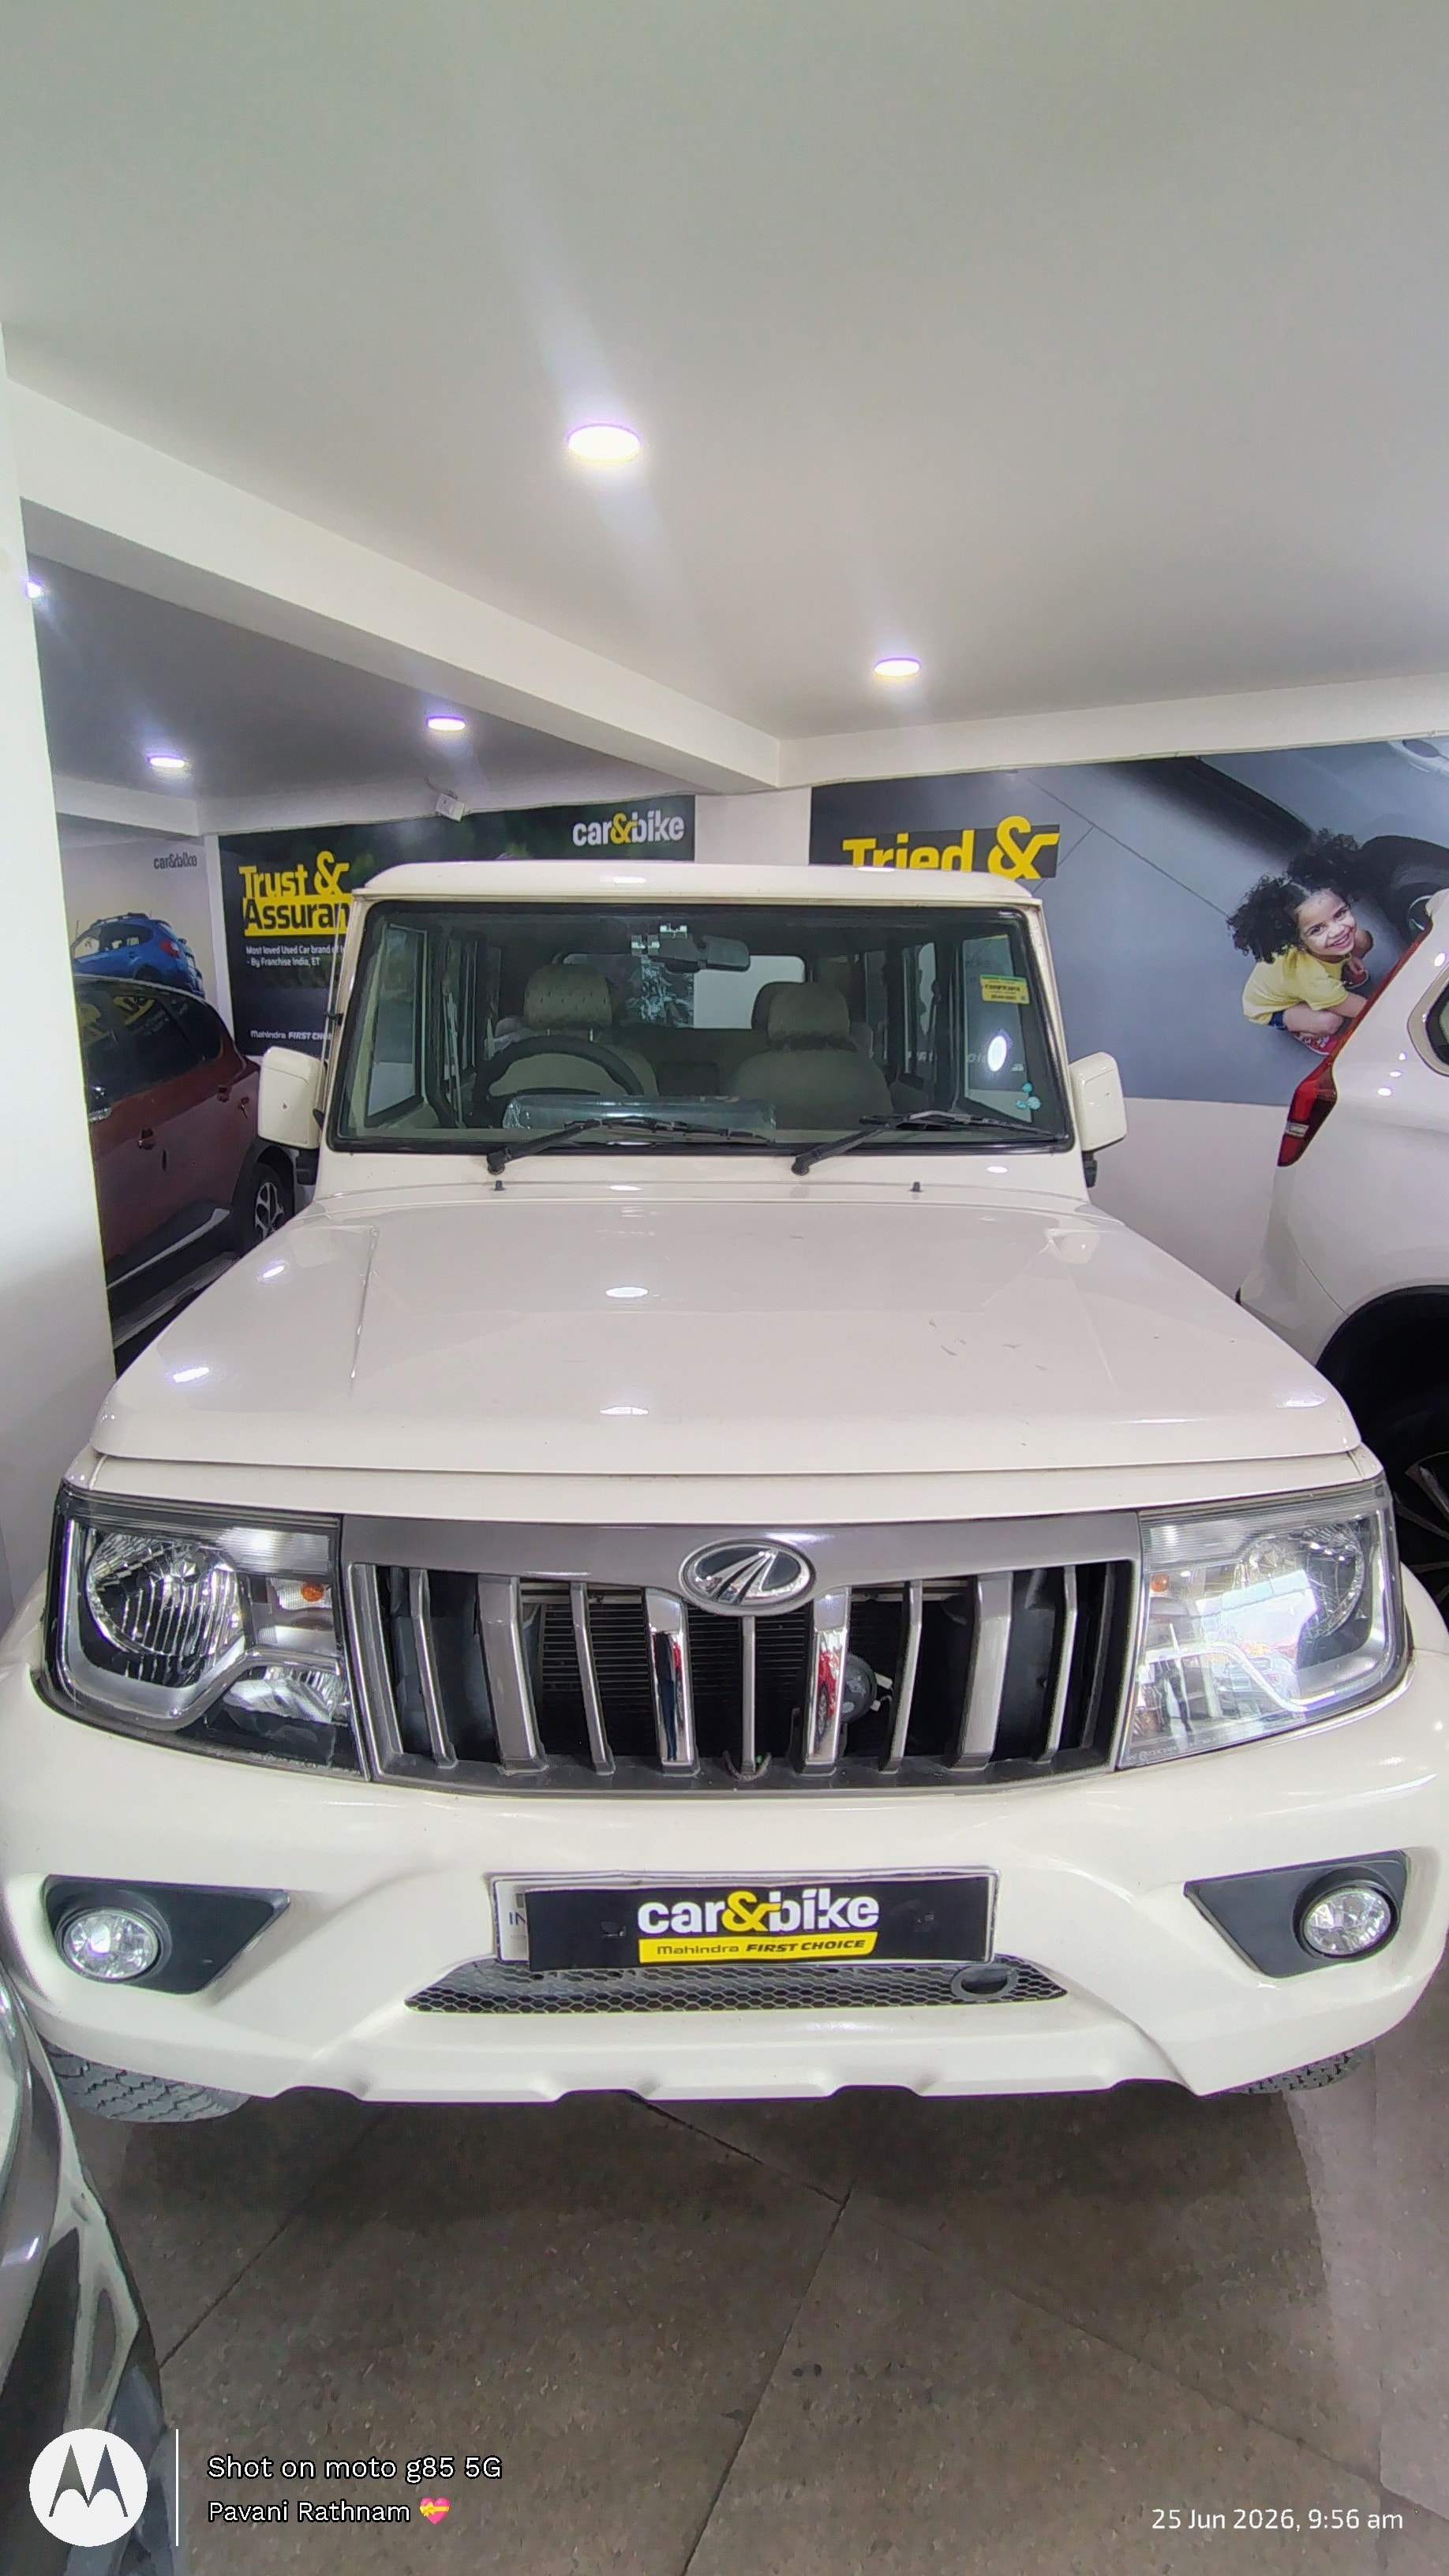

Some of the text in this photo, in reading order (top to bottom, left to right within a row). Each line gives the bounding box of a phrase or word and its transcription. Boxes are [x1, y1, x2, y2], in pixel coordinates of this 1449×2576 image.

[572, 809, 685, 847] car&bike
[841, 815, 1060, 881] Tried &
[153, 852, 198, 870] car&bike
[238, 850, 350, 898] Trust &
[245, 945, 262, 955] Most
[263, 945, 280, 954] loved
[281, 945, 298, 954] Used
[299, 945, 310, 954] Car
[311, 945, 331, 954] brand
[250, 957, 260, 968] By
[260, 957, 291, 967] Franchise
[311, 957, 320, 966] ET
[250, 1030, 286, 1039] Mahindra
[288, 1032, 311, 1040] FIRST
[637, 1887, 880, 1934] car&bike
[657, 1939, 867, 1955] Mahindra FIRST CHOICE
